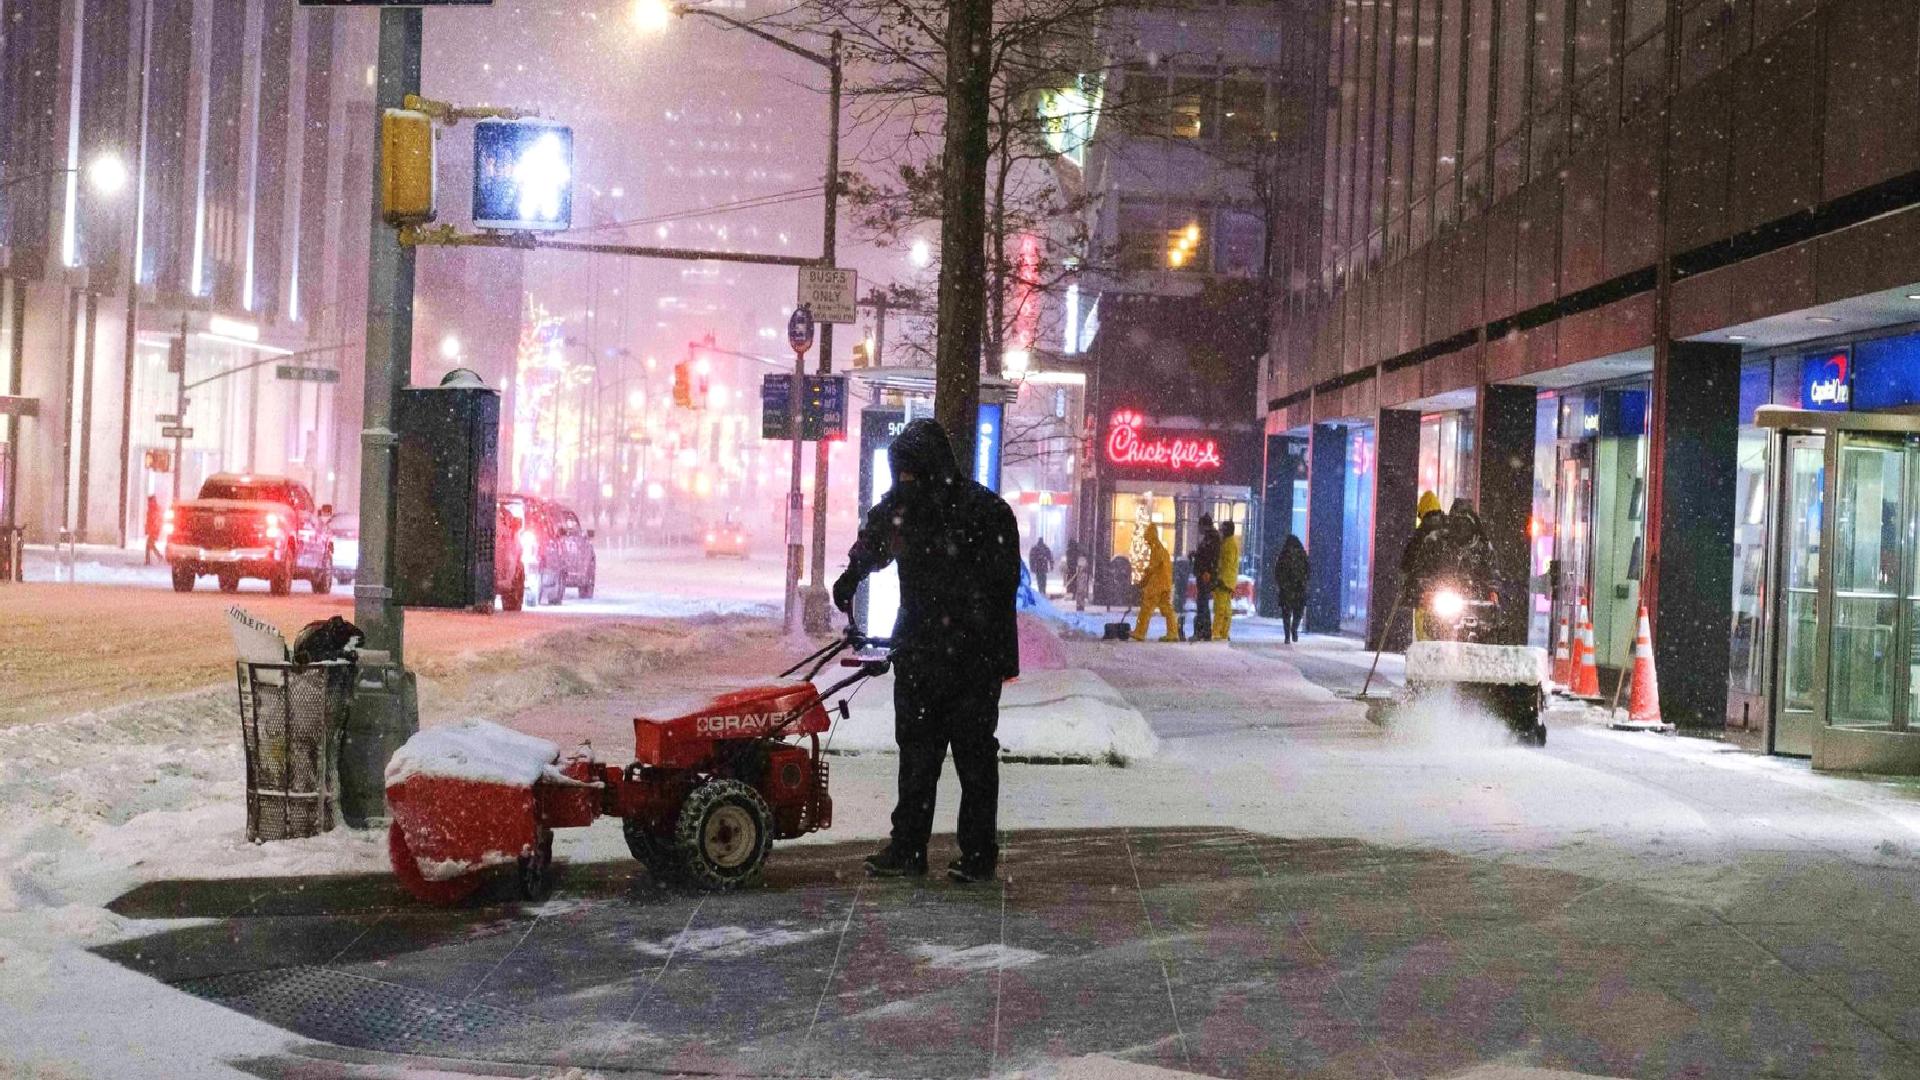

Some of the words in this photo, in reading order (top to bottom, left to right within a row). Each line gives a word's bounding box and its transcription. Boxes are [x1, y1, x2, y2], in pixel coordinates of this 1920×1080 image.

[809, 271, 846, 284] BUSES
[812, 290, 841, 302] ONLY
[1108, 421, 1221, 469] Chick-fil-A
